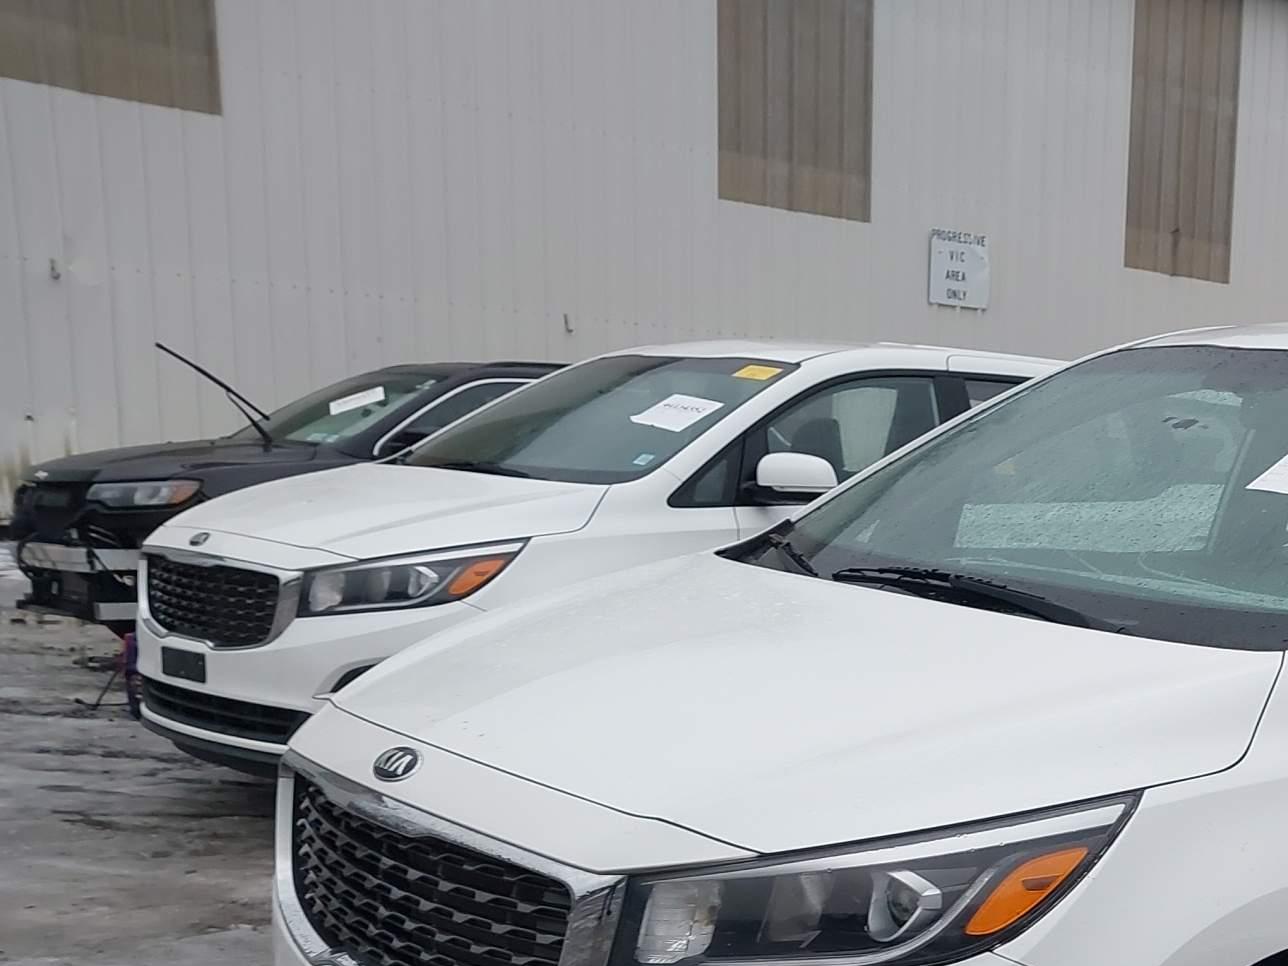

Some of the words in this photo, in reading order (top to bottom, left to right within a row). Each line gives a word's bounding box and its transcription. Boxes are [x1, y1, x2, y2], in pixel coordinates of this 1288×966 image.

[931, 228, 986, 247] PROGRESSIVE
[948, 250, 966, 263] VIC
[945, 269, 966, 282] AREA
[946, 288, 967, 301] ONLY
[374, 748, 415, 777] KIA
